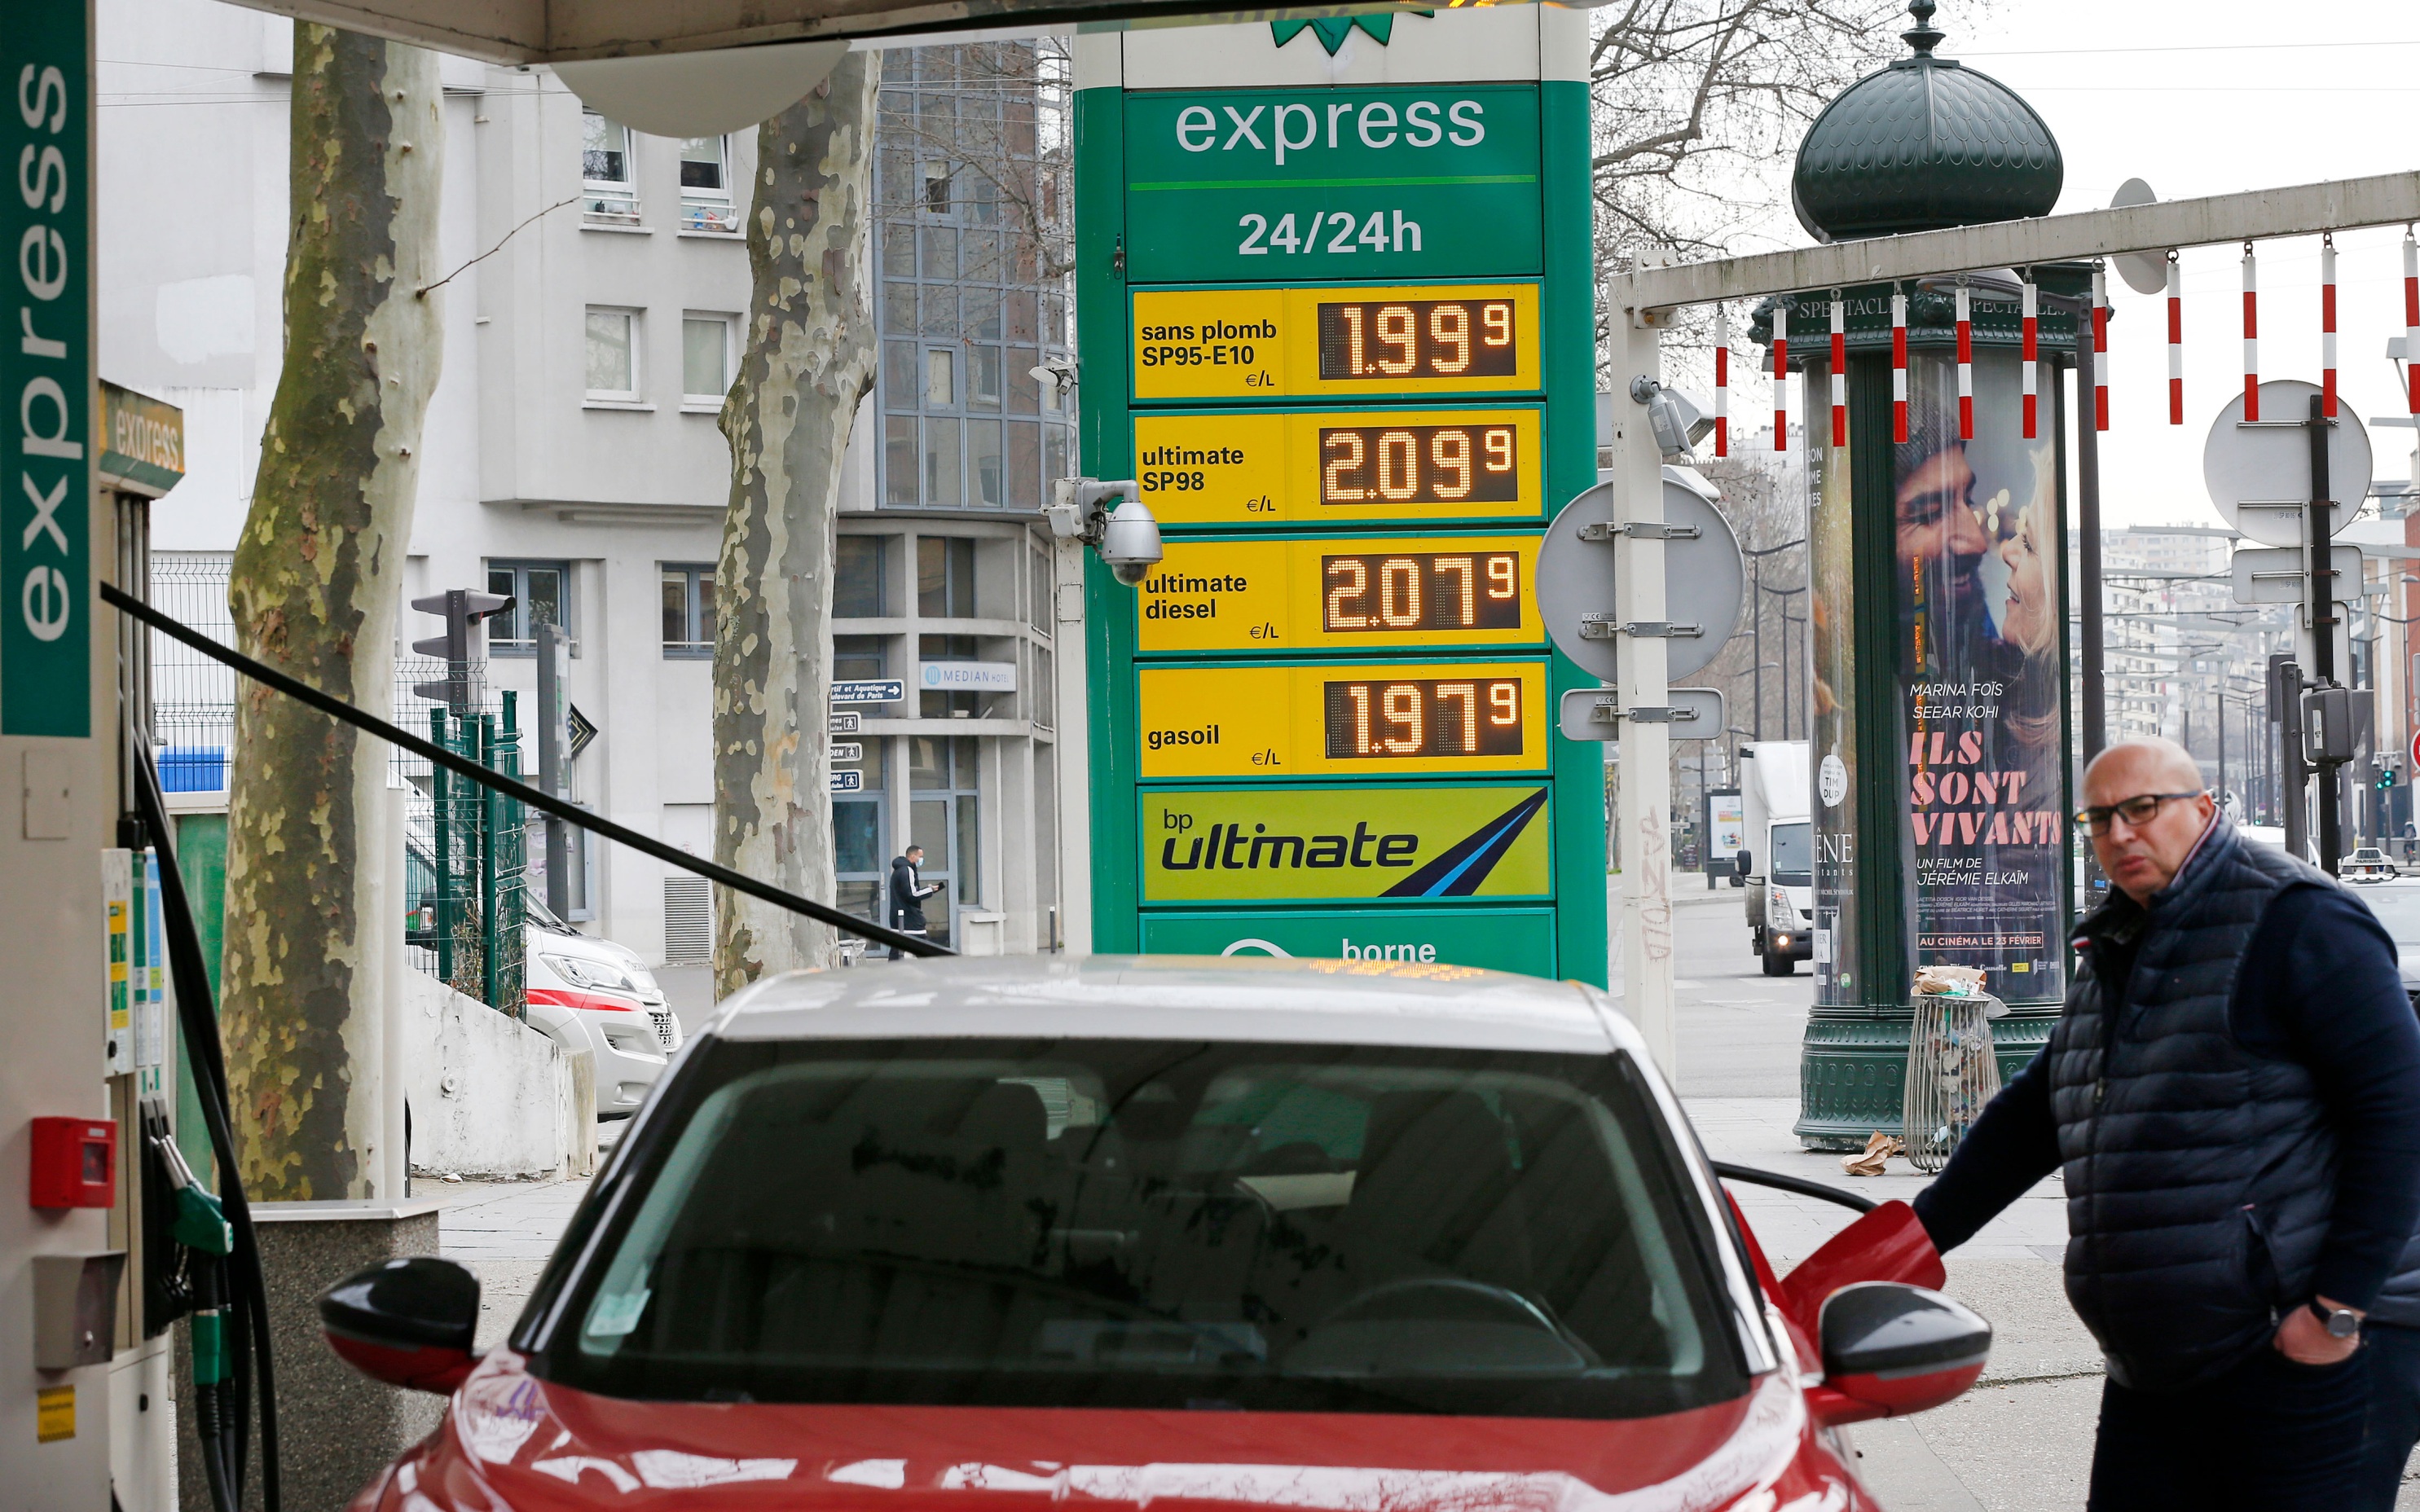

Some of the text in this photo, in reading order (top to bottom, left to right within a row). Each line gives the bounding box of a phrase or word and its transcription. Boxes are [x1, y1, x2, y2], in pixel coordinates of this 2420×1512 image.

[1176, 99, 1485, 165] express
[1238, 210, 1422, 255] 24/24h
[1800, 297, 1909, 319] SPETACL
[1969, 300, 2066, 315] PECTALE
[1142, 319, 1277, 344] sans plomb
[19, 64, 82, 641] express
[1142, 345, 1254, 366] SP95-E10
[1245, 371, 1275, 387] €/L
[116, 409, 178, 472] express
[1142, 446, 1244, 465] ultimate
[1142, 472, 1204, 491] SP98
[1246, 495, 1276, 512] €/L
[1146, 574, 1247, 593] ultimate
[1146, 599, 1216, 619] diesel
[1249, 622, 1279, 639] €/L
[944, 670, 989, 682] MEDIAN
[992, 675, 1009, 683] HOTEL
[854, 684, 887, 693] Aquatique
[1910, 683, 2003, 697] MARINA FOÏS
[1912, 705, 1999, 718] SEEAR KOHI
[1147, 725, 1219, 749] gasoil
[1252, 749, 1281, 765] €/L
[1909, 731, 1982, 765] ILS
[1825, 776, 1838, 787] TIM
[1911, 771, 2027, 806] SONT
[1824, 789, 1840, 799] DUP
[1163, 808, 1193, 834] bp
[1911, 811, 2061, 846] VIVANTS
[1162, 821, 1418, 871] ultimate
[1814, 826, 1854, 864] ÊNE
[1917, 859, 1982, 868] UN FILM DE
[1916, 870, 2028, 886] JÉRÉMIE ELKAÏM
[1920, 938, 1934, 946] AU
[1938, 936, 1978, 946] CINÉMA
[1995, 937, 2006, 945] 23
[2009, 935, 2042, 945] FÉVRIER
[1342, 938, 1437, 963] borne
